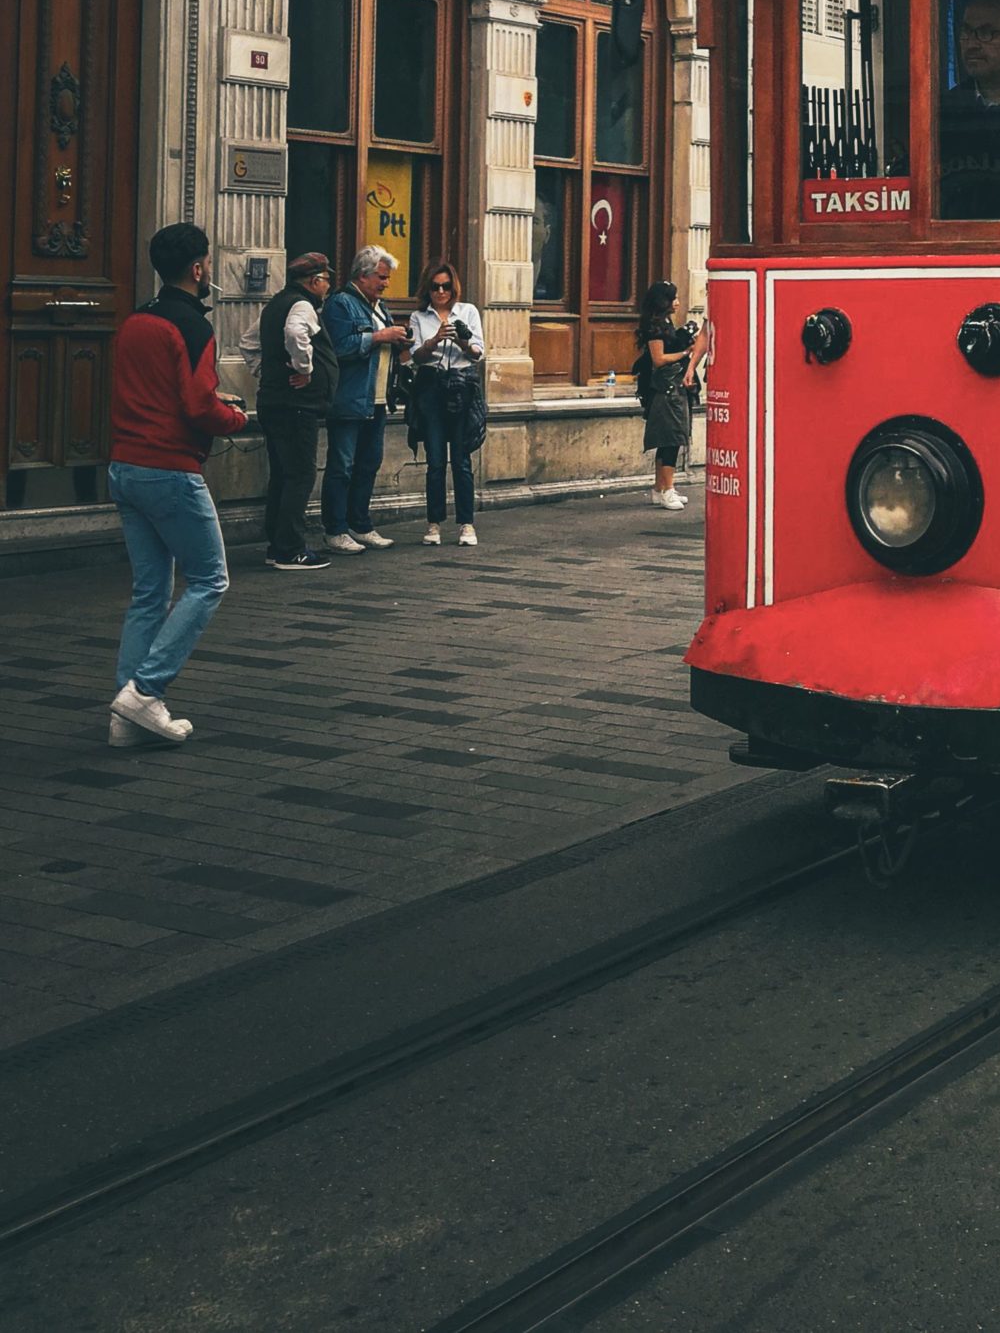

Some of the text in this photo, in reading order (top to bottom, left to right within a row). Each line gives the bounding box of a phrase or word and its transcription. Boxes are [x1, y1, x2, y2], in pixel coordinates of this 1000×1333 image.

[811, 186, 911, 213] TAKSİM
[379, 210, 406, 238] Ptt
[714, 407, 730, 423] 153
[712, 448, 739, 469] YASAK
